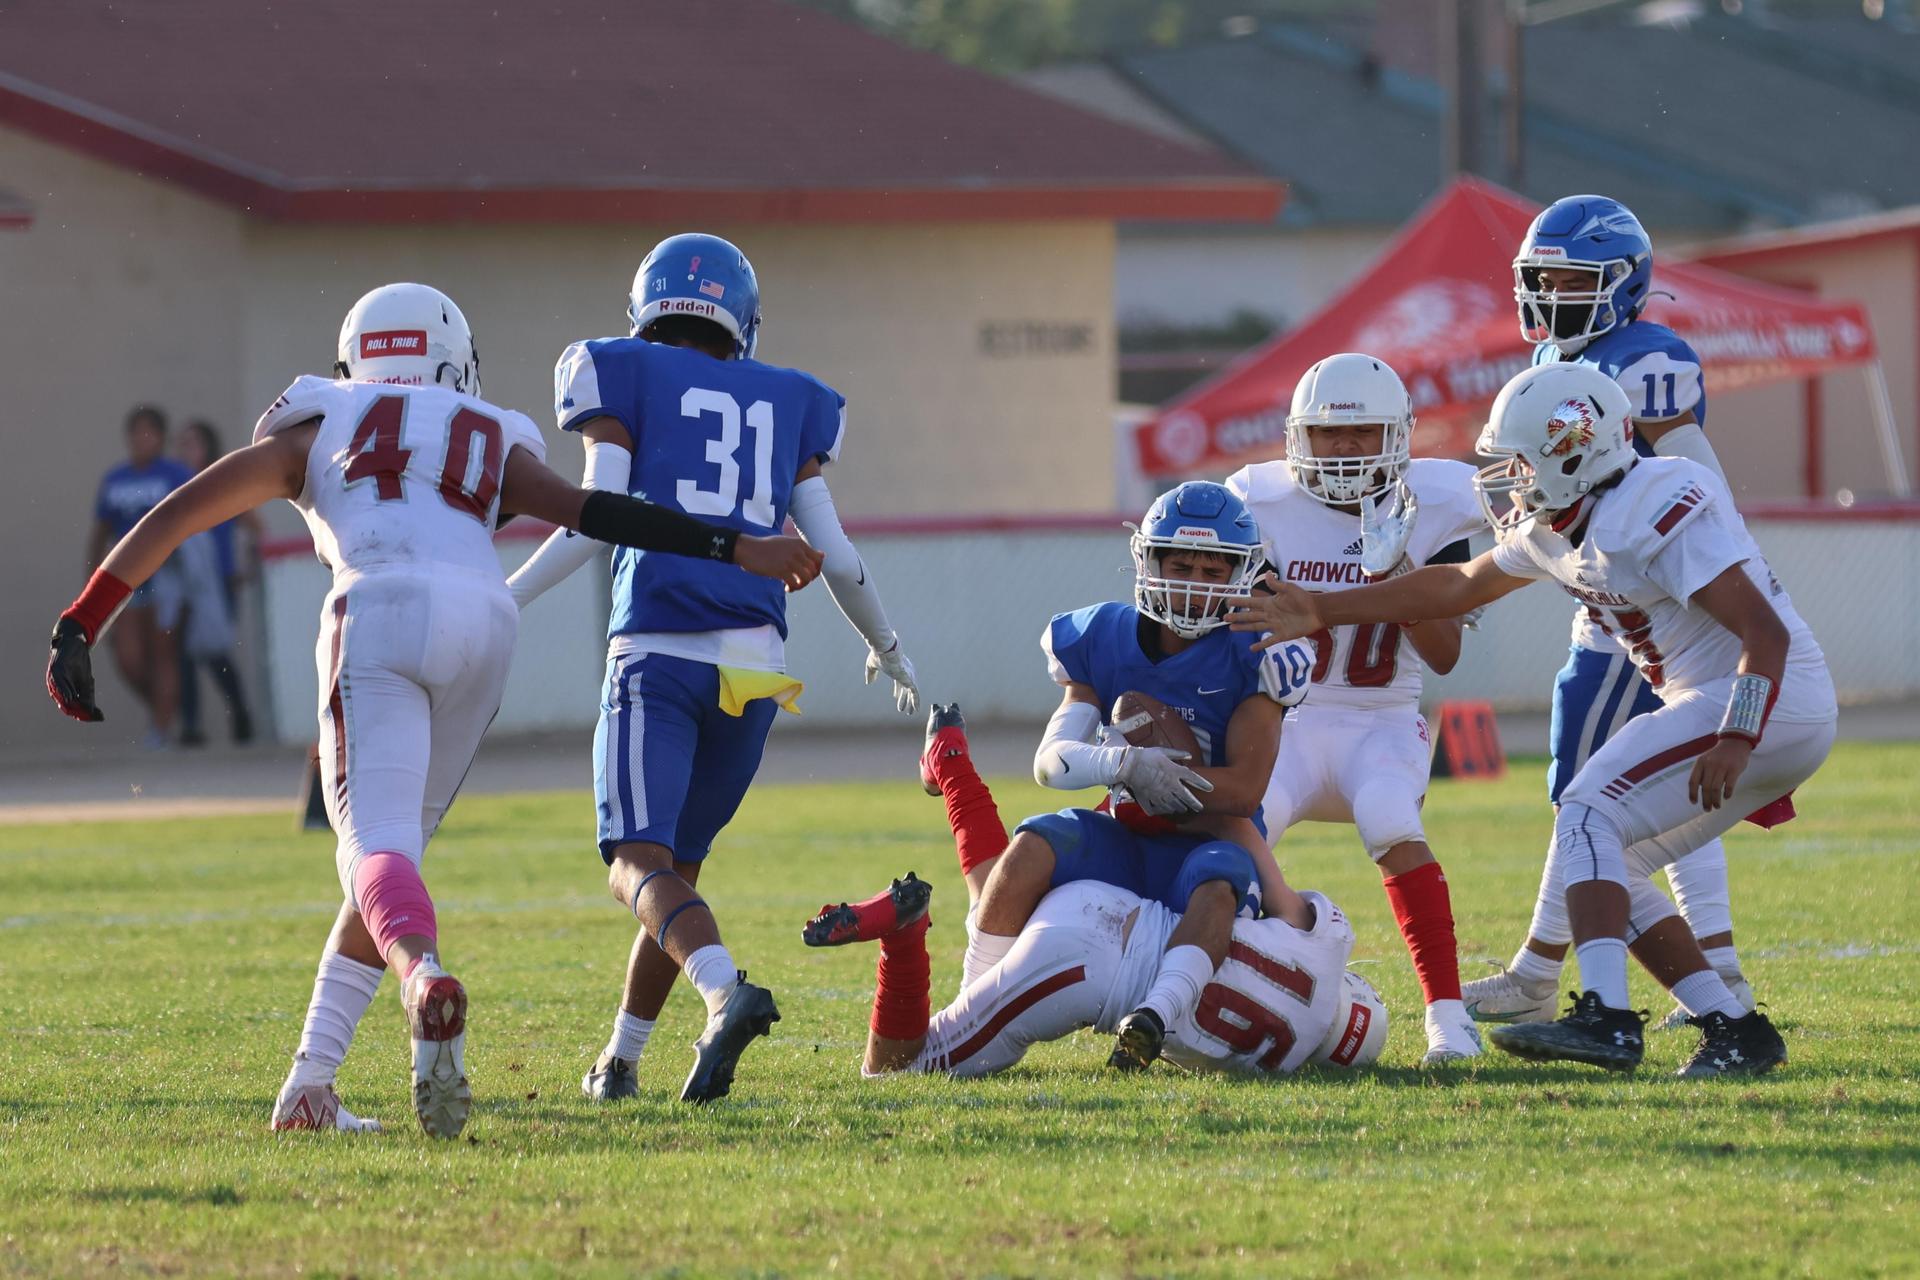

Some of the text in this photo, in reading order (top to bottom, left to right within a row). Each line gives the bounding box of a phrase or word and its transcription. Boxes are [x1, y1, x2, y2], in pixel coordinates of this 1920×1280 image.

[660, 300, 716, 316] Riddell
[366, 336, 419, 351] ROLL TRIBE
[1329, 402, 1357, 411] Riddell
[1641, 373, 1680, 418] 11
[342, 393, 505, 527] 40
[676, 387, 776, 529] 31
[1272, 644, 1310, 699] 10
[1194, 936, 1317, 1070] 16
